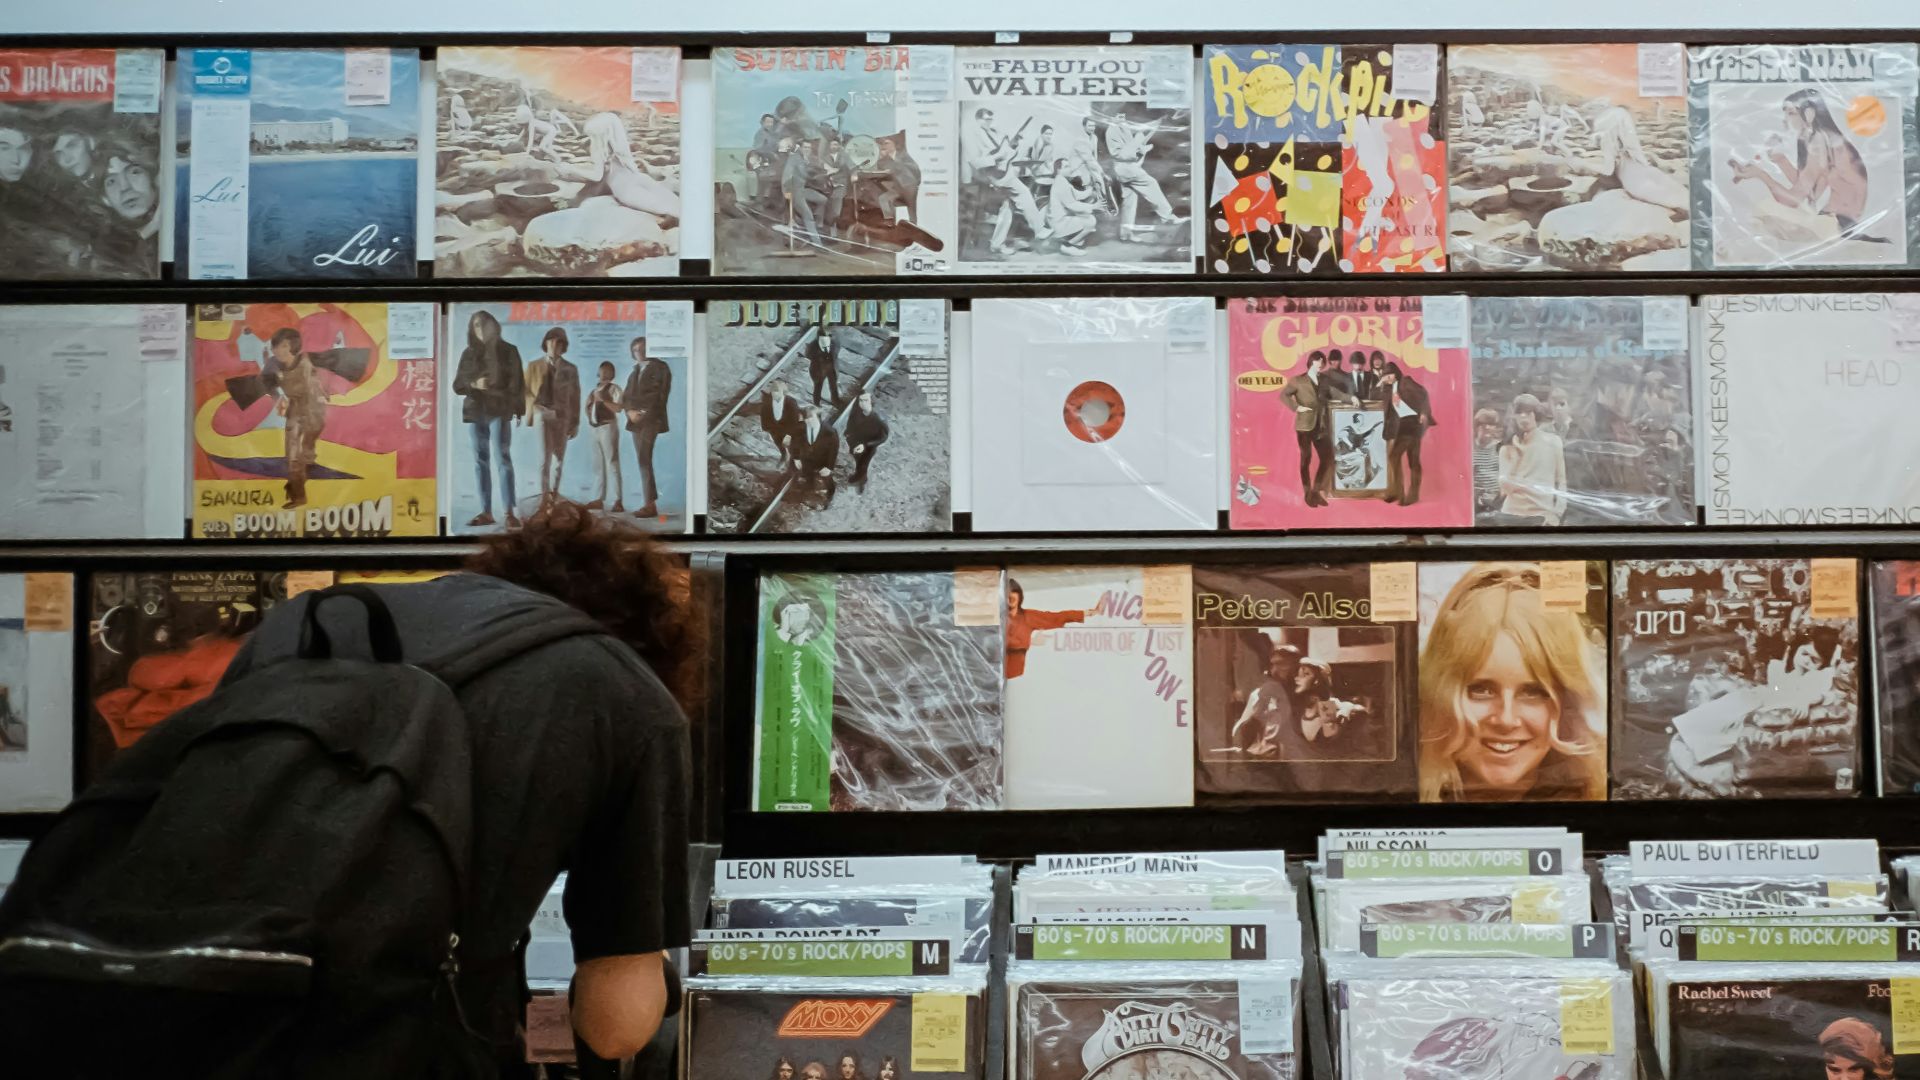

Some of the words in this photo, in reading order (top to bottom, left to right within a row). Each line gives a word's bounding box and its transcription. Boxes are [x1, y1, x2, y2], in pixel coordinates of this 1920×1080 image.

[863, 47, 909, 71] BIR
[992, 60, 1144, 74] FABULOU
[23, 61, 108, 93] BRINCOS
[313, 223, 401, 267] Lui
[725, 299, 800, 326] BLUE
[1825, 359, 1902, 387] HEAD
[201, 490, 274, 507] SAKURA
[234, 510, 302, 533] BOOM
[311, 495, 398, 533] BOOM
[1101, 590, 1143, 620] NIC
[1197, 594, 1290, 620] Peter
[1297, 592, 1372, 620] Also
[1054, 631, 1113, 652] LABOUR
[1118, 631, 1137, 652] OF
[1429, 851, 1523, 868] ROCK/POPS
[1643, 843, 1690, 861] PAUL
[1698, 843, 1820, 861] BUTTERFIELD
[726, 861, 776, 879] LEON
[783, 860, 854, 879] RUSSEL
[1144, 855, 1199, 873] MANN
[1037, 927, 1119, 945] 60's-70's
[1125, 926, 1225, 945] ROCK/POPS
[1241, 927, 1256, 949] N
[1467, 924, 1566, 942] ROCK/POPS
[1582, 925, 1596, 947] P
[1700, 926, 1783, 945] 60's-70's
[1788, 926, 1890, 945] ROCK/POPS
[711, 943, 796, 961] 60's-70's
[802, 942, 906, 960] ROCK/POPS
[921, 943, 940, 965] M
[1678, 985, 1729, 999] Rachel
[1731, 986, 1773, 999] Sweet
[779, 1000, 890, 1035] MOXY
